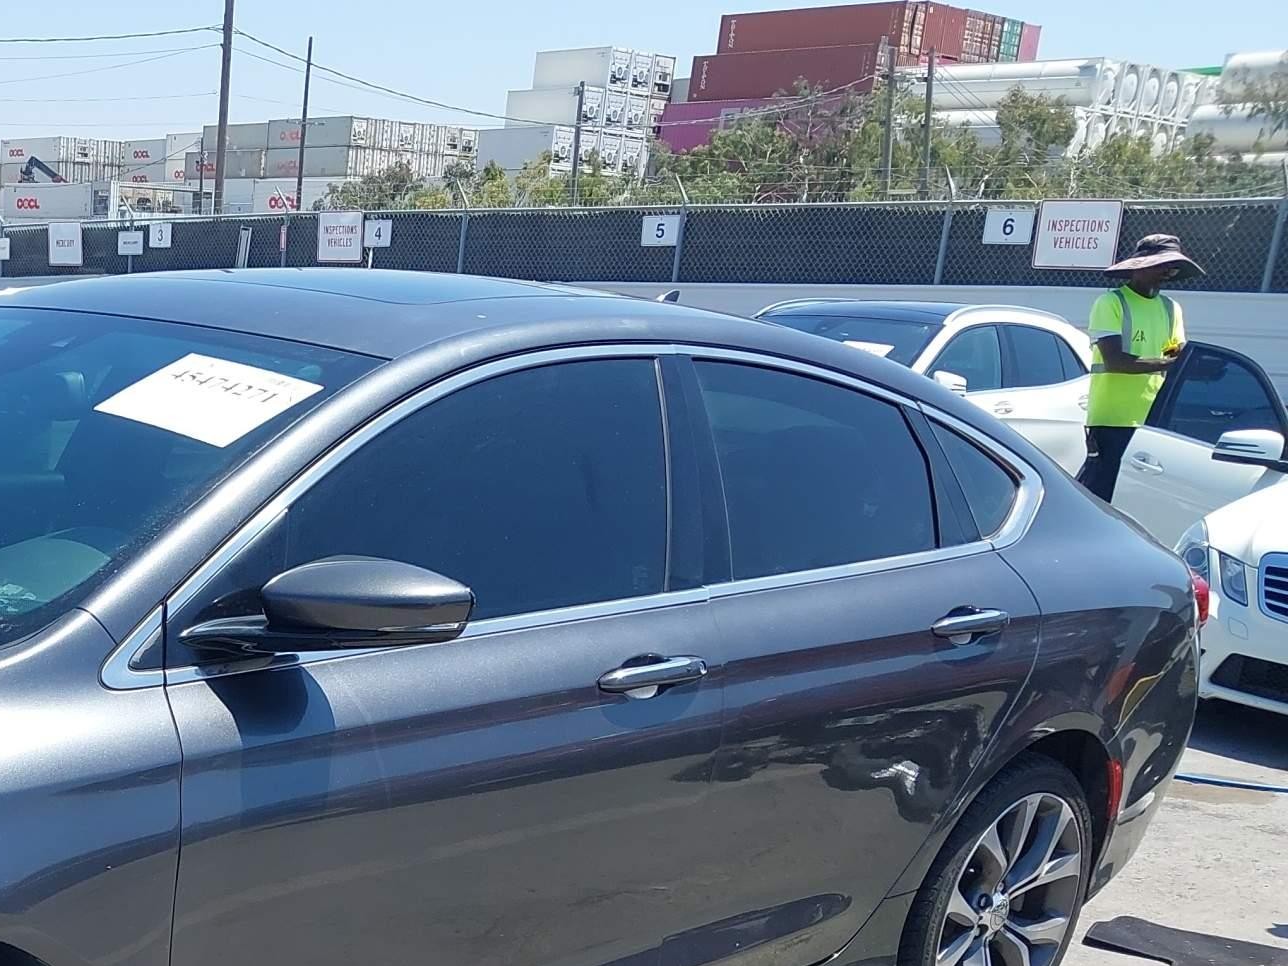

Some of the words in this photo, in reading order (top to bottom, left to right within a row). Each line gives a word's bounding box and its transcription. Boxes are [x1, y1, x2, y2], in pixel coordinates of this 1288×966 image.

[133, 150, 150, 159] OOCL
[16, 198, 40, 209] OOCL
[323, 224, 358, 235] INSPECTIONS
[655, 222, 665, 239] 5
[1002, 217, 1015, 236] 6
[1047, 218, 1110, 233] INSPECTIONS
[157, 229, 164, 242] 3
[374, 226, 382, 240] 4
[327, 238, 353, 248] VEHICLES
[1053, 236, 1099, 250] VEHICLES
